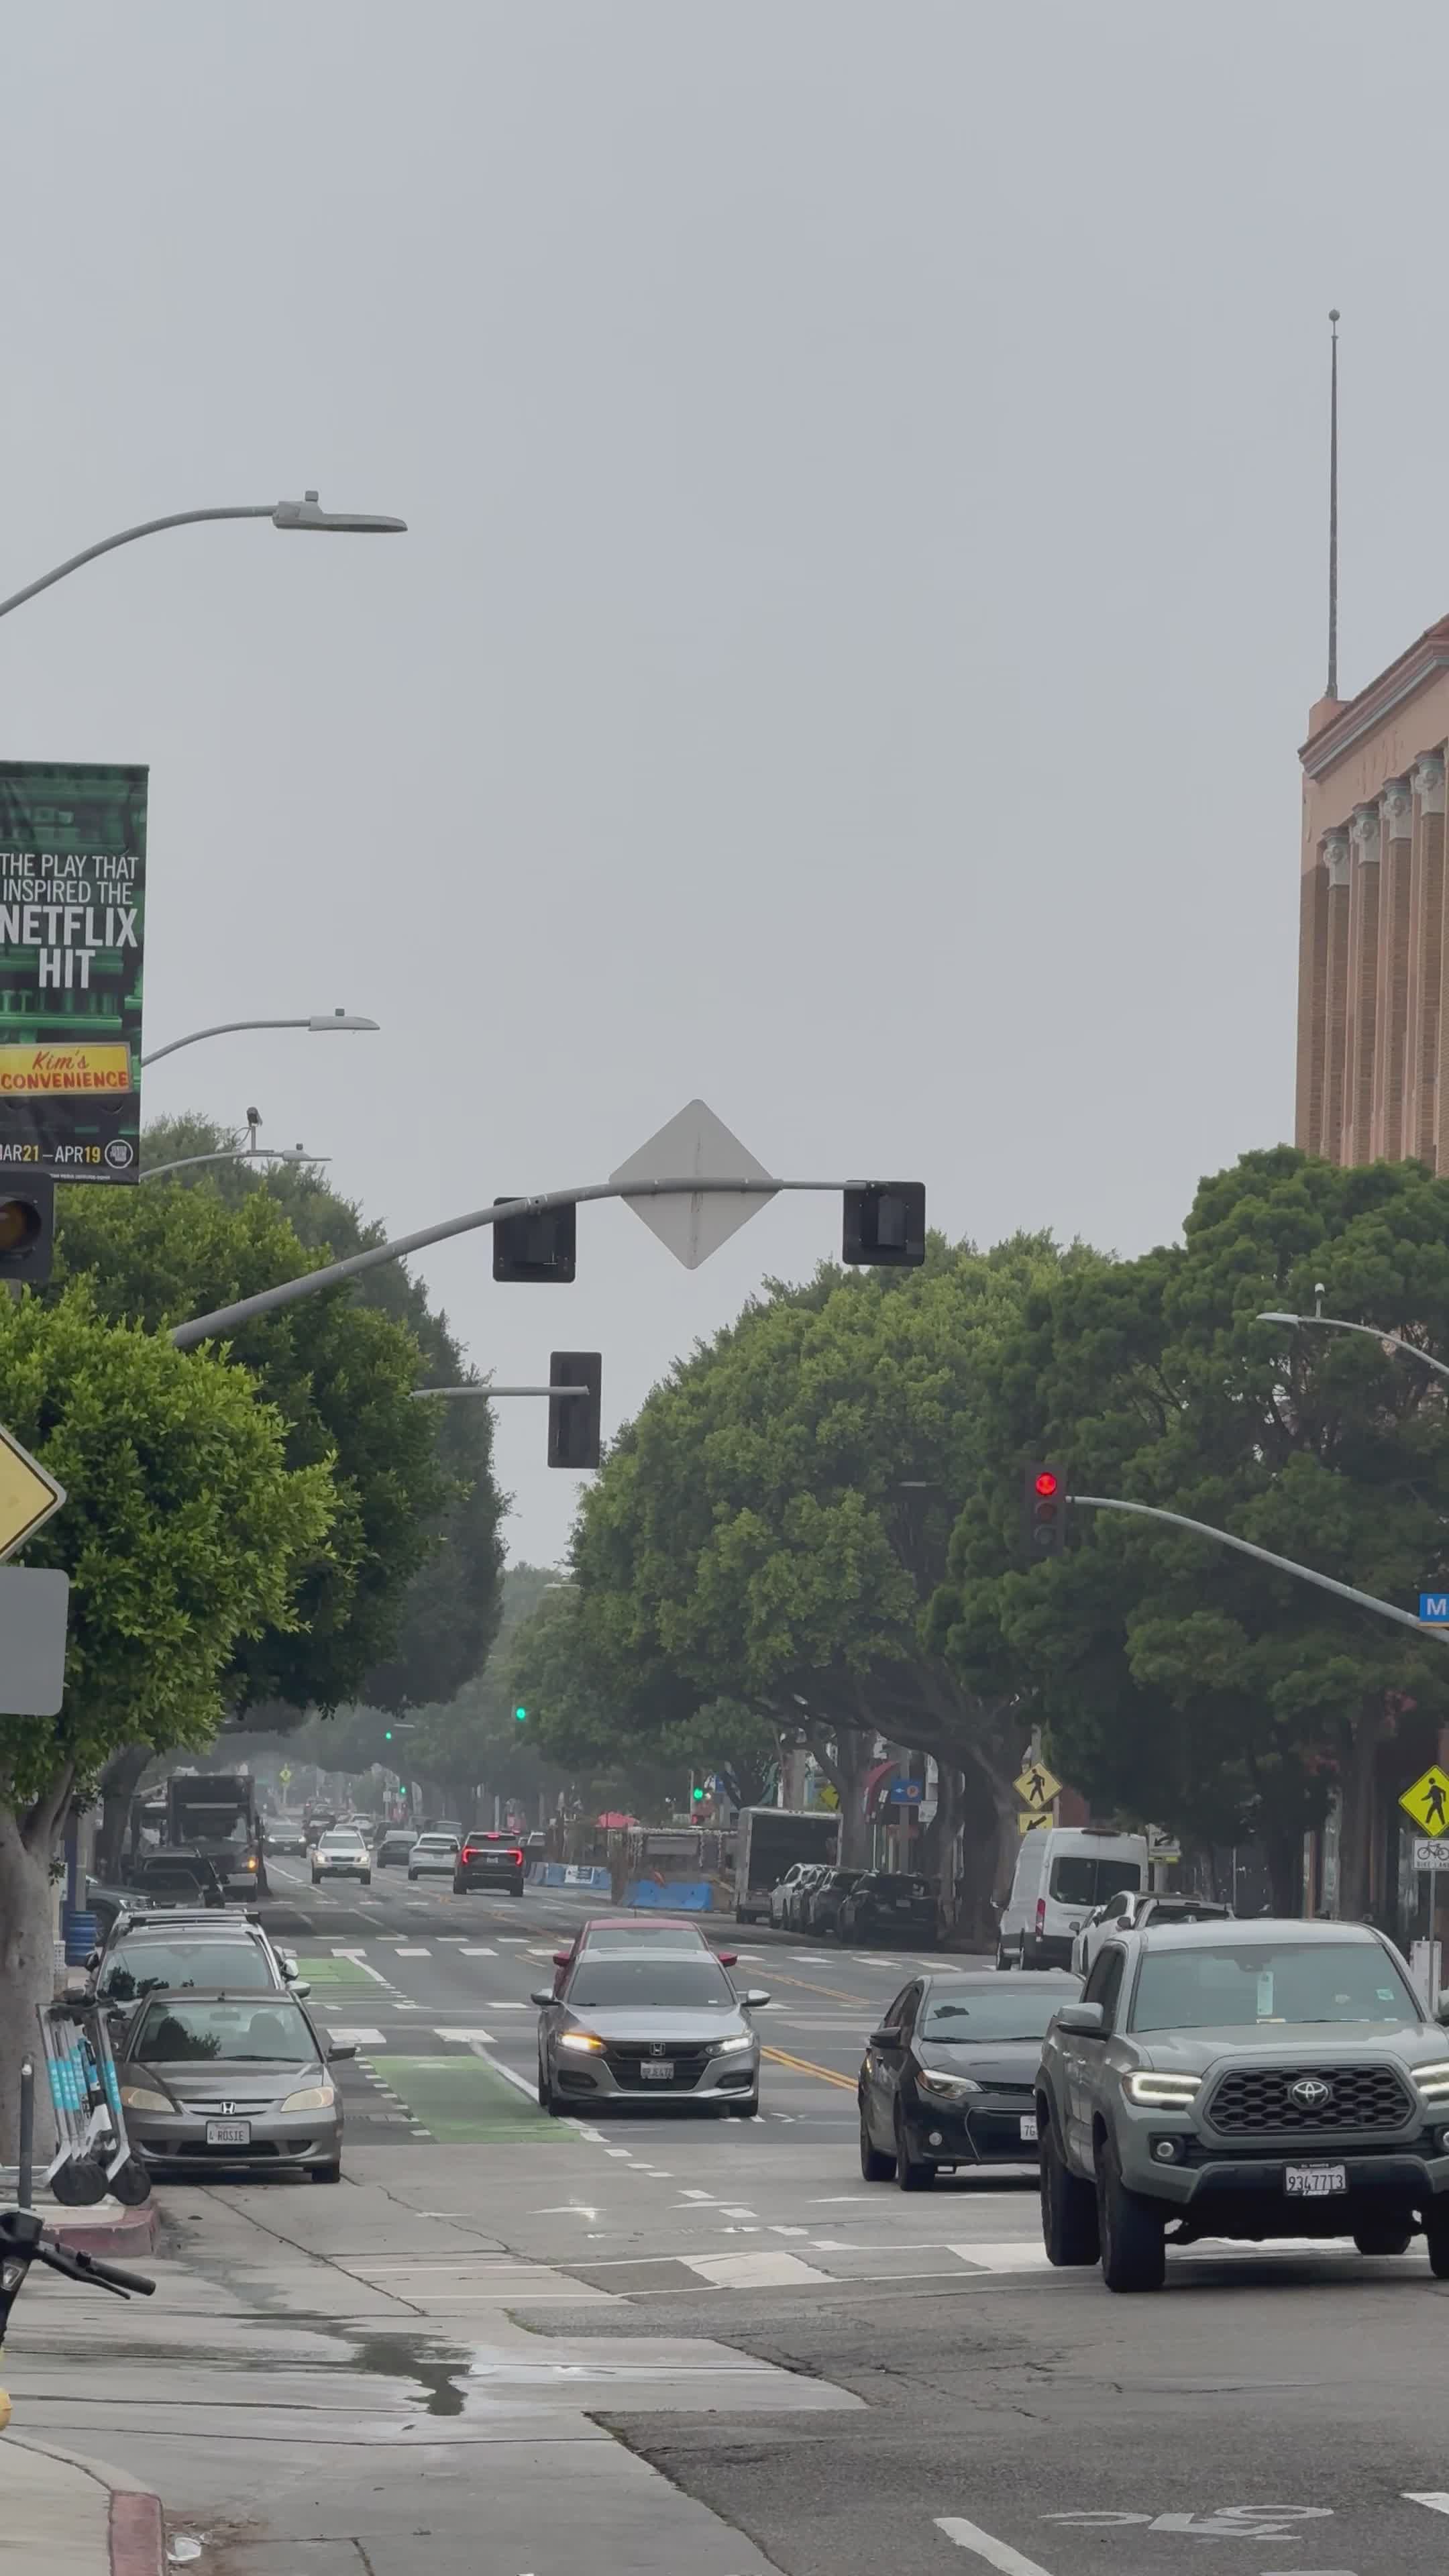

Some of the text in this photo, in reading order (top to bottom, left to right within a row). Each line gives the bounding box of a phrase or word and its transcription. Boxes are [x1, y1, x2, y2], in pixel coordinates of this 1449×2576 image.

[0, 853, 139, 879] THE PLAY THAT
[3, 879, 133, 904] INSPIRED THE
[0, 904, 138, 947] NETFLIX
[39, 948, 96, 988] HIT
[32, 1049, 89, 1070] Kim's
[1, 1071, 128, 1089] CONVENIENCE
[0, 1144, 39, 1162] AR21
[217, 2130, 244, 2141] ROSIE
[1288, 2174, 1343, 2190] 93477T3
